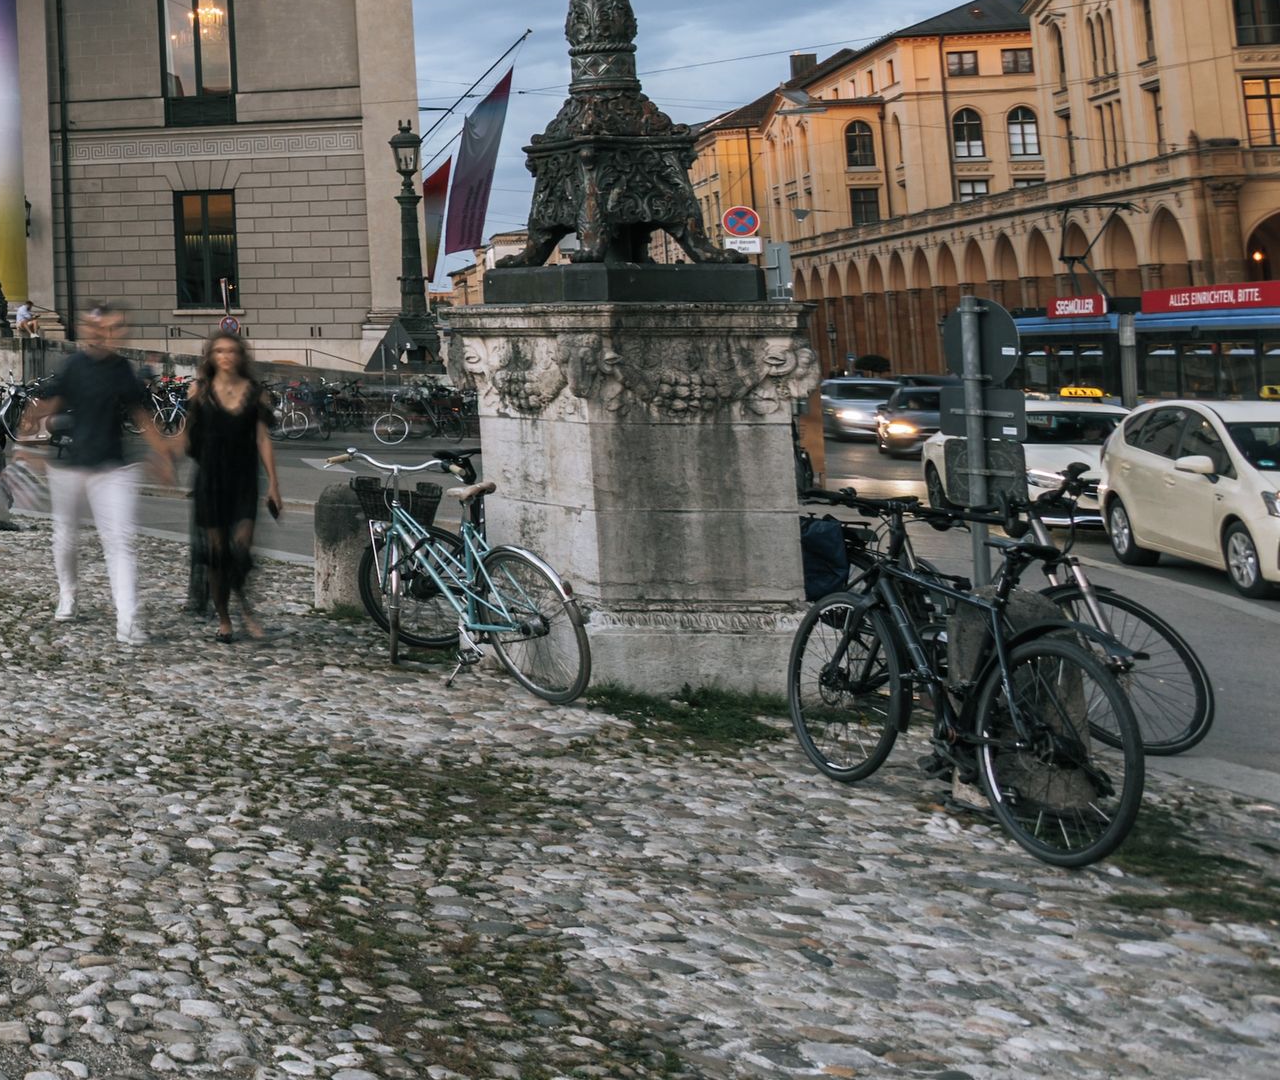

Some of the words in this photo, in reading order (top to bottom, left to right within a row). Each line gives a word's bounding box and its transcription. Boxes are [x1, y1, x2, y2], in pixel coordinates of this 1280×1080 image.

[1169, 292, 1190, 307] ALLES
[1191, 289, 1236, 305] EINRICHTEN,
[1237, 288, 1262, 303] BITTE.
[1055, 299, 1094, 315] SEGMÜLLER
